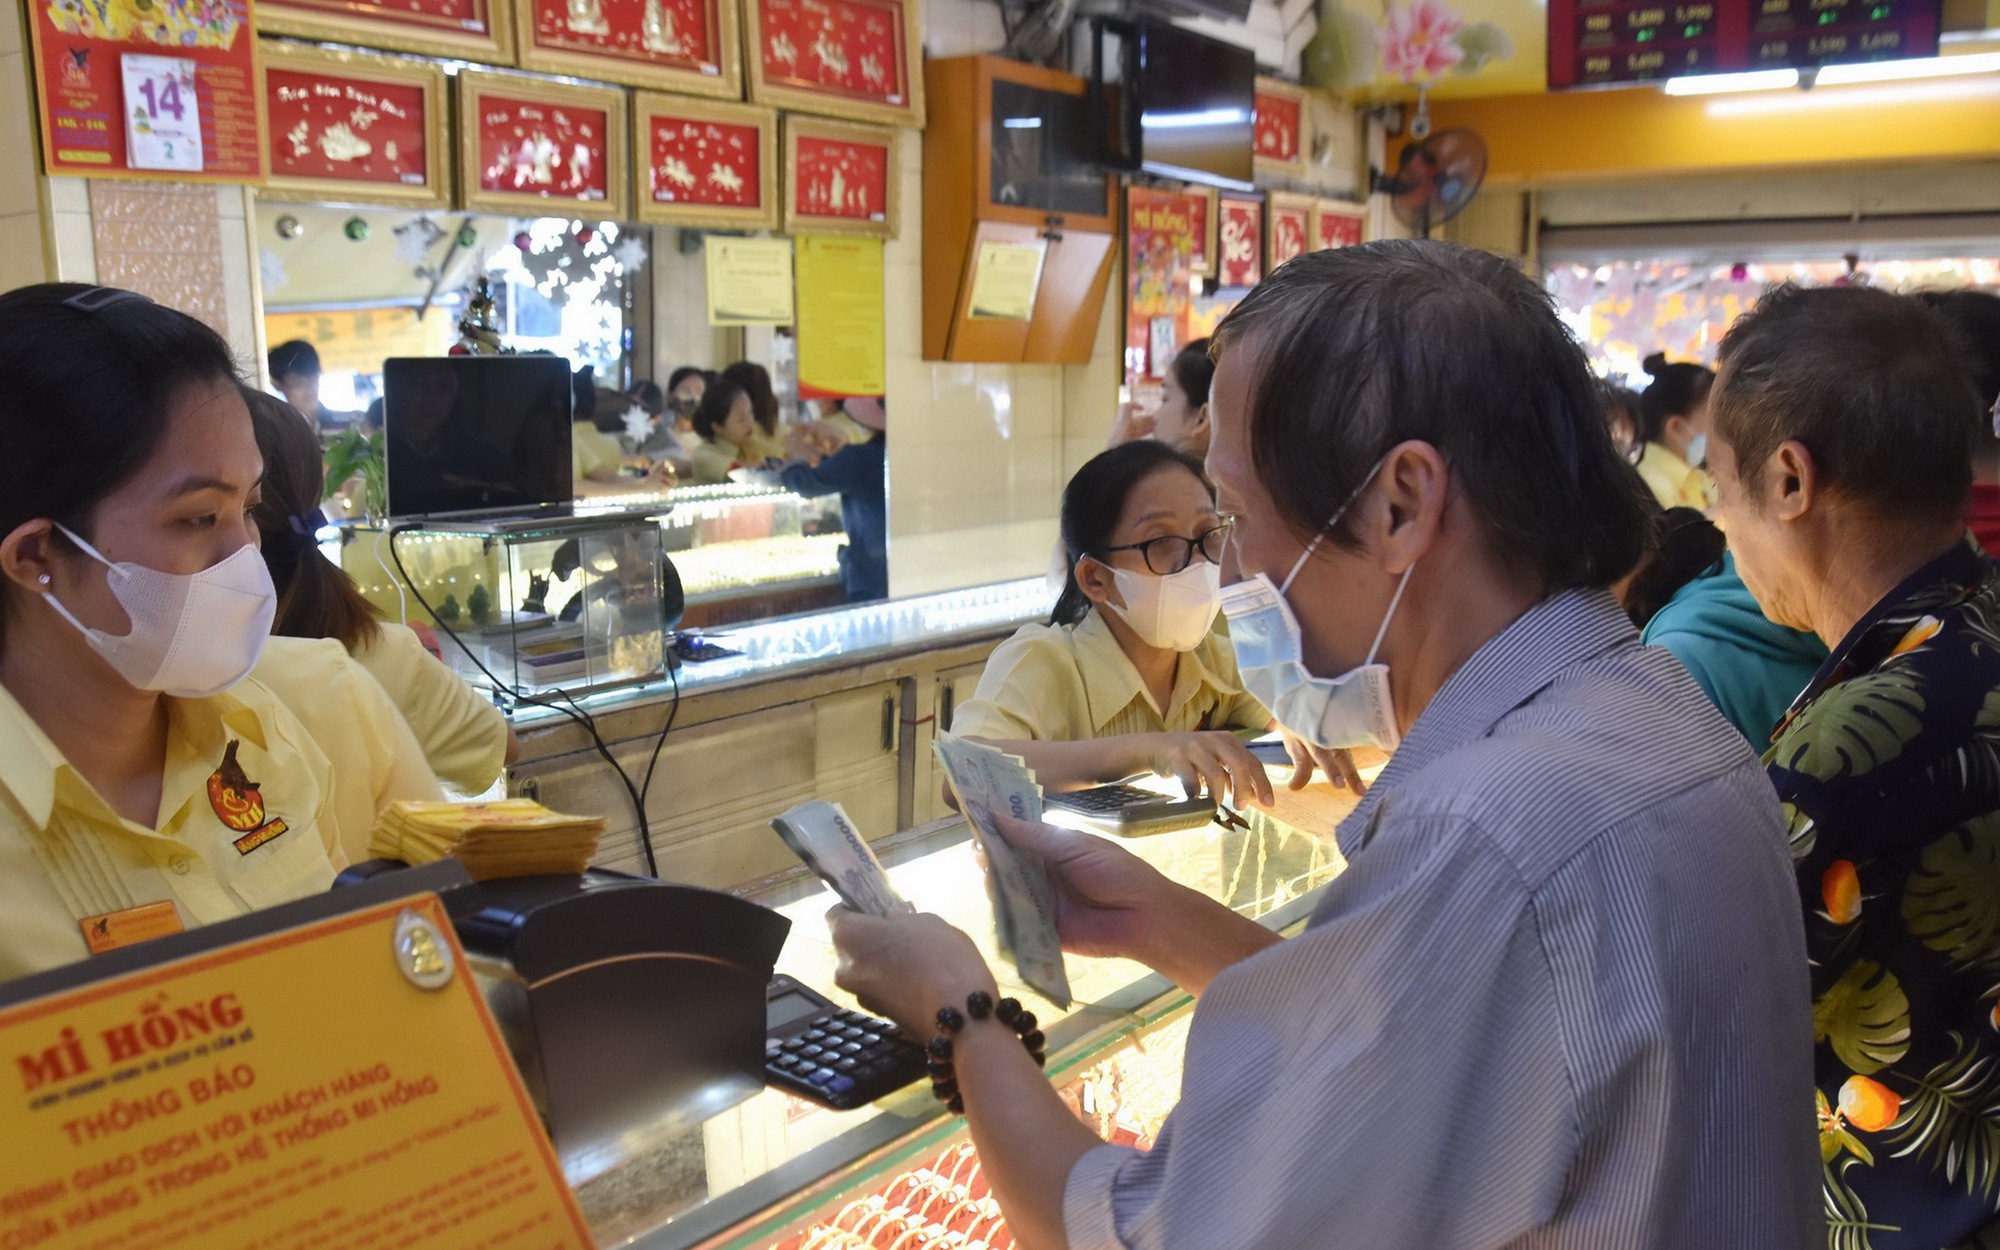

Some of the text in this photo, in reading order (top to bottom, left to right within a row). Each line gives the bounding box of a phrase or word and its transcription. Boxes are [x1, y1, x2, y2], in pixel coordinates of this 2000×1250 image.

[139, 77, 185, 121] 14
[163, 141, 175, 160] 2
[832, 813, 876, 873] 500000
[101, 991, 245, 1065] HỒNG
[63, 1088, 183, 1147] THÔNG
[188, 1061, 256, 1106] BÁO
[72, 1153, 138, 1191] GIAO
[250, 1085, 328, 1127] KHÁCH
[331, 1062, 392, 1097] HÀNG
[145, 1152, 232, 1197] TRONG
[234, 1133, 269, 1166] HỆ
[272, 1108, 350, 1149] THỐNG
[352, 1097, 379, 1121] MI
[380, 1074, 440, 1111] HỒNG
